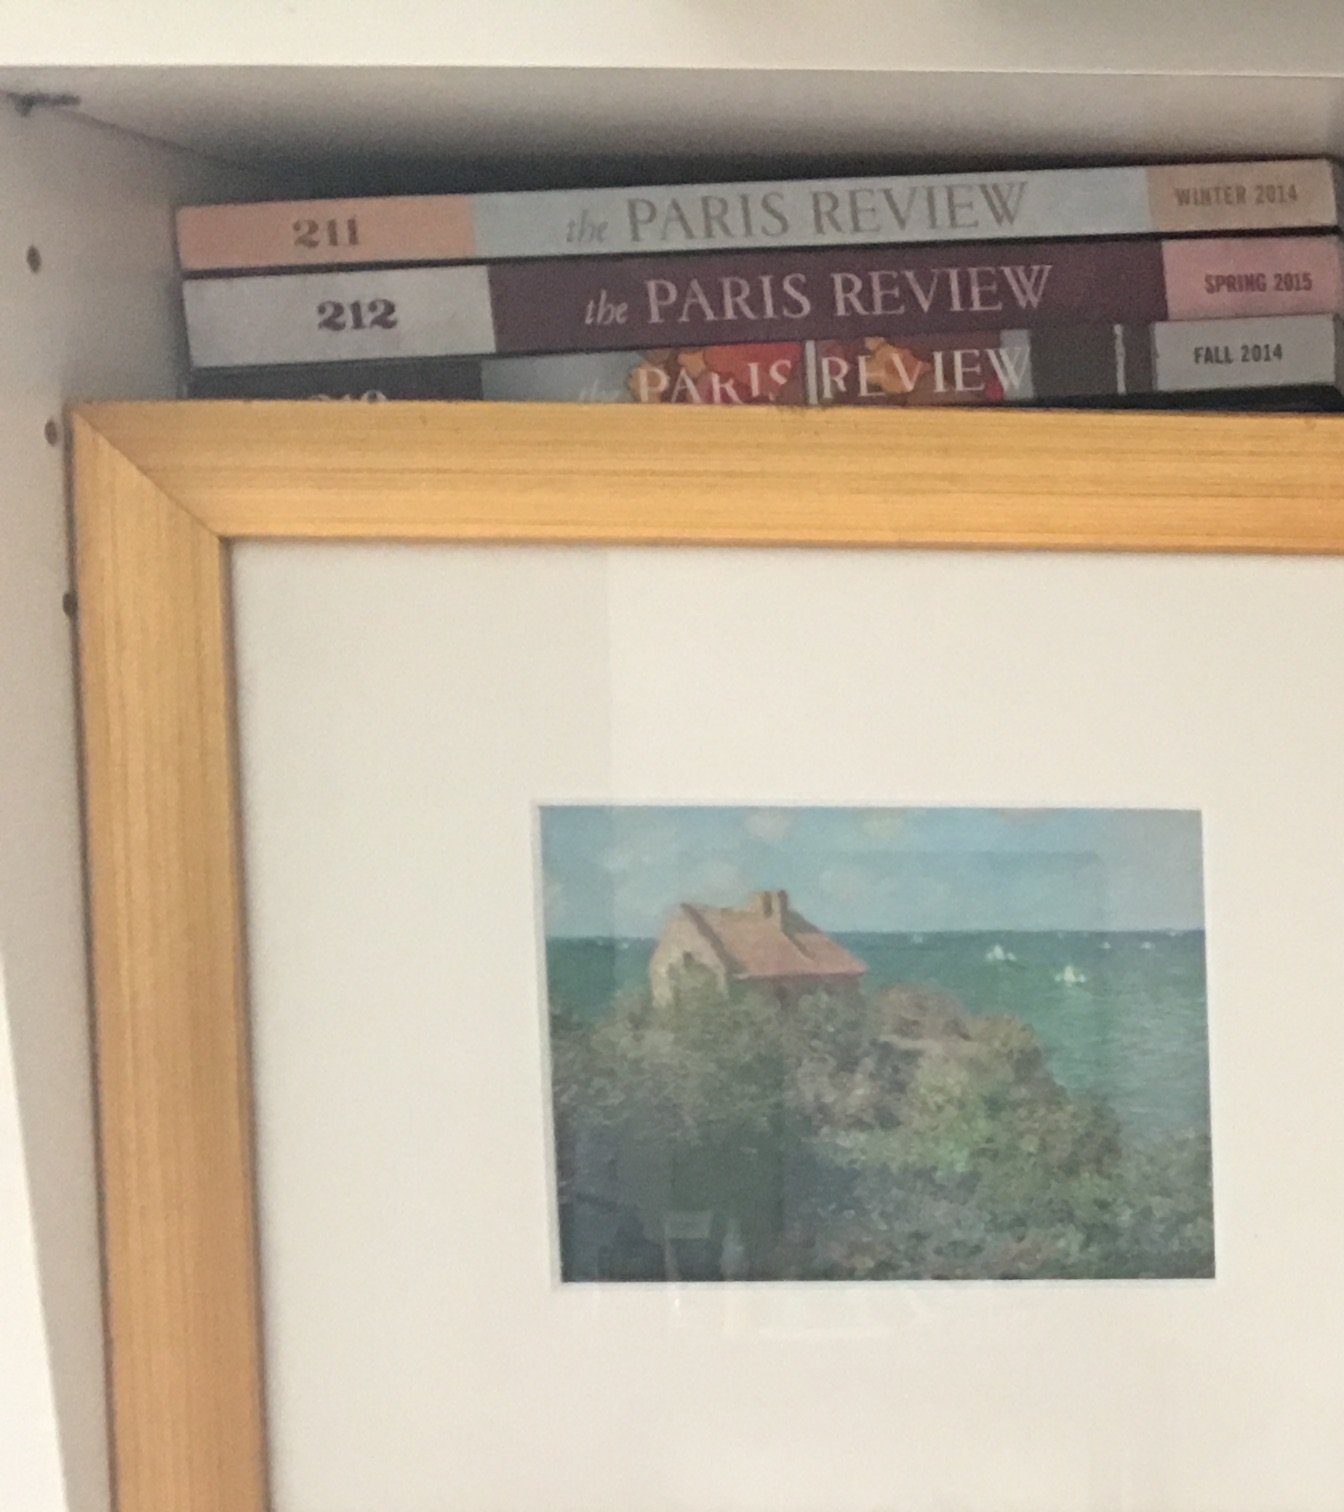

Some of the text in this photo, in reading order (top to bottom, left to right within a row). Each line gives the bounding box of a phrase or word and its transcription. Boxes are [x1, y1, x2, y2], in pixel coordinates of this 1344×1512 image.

[1174, 184, 1298, 208] WINTER 2014
[567, 181, 1028, 244] the PARIS REVIEW
[293, 217, 360, 249] 211
[585, 264, 1053, 326] the PARIS REVIEW
[1205, 272, 1312, 295] SPRING 2015
[317, 299, 398, 332] 212
[1194, 344, 1283, 366] FALL 2014
